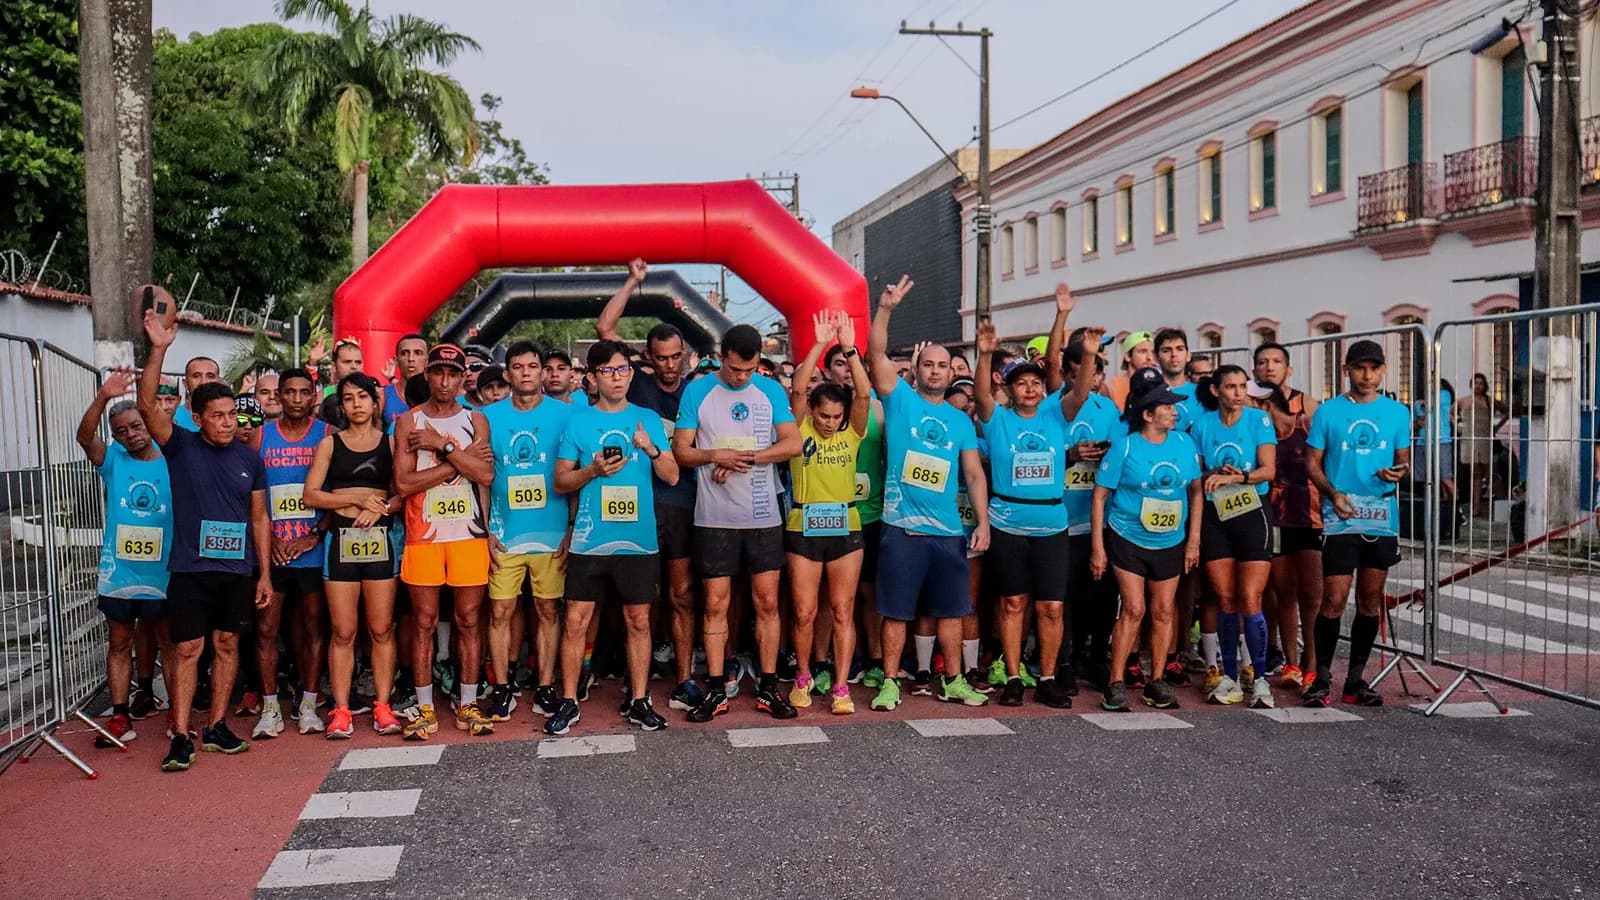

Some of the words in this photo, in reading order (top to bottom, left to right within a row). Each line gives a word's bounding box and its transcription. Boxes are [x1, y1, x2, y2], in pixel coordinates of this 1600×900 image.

[817, 440, 849, 454] Planeta
[816, 452, 852, 467] Energia
[912, 467, 940, 485] 685
[1017, 466, 1047, 478] 3837
[514, 488, 543, 503] 503
[1225, 492, 1252, 511] 446
[279, 498, 306, 512] 496
[437, 500, 466, 515] 346
[608, 500, 635, 515] 699
[957, 506, 973, 520] 56
[1150, 513, 1176, 527] 328
[1354, 507, 1385, 520] 3872
[810, 517, 841, 528] 3906
[125, 540, 153, 555] 635
[208, 537, 240, 550] 3934
[351, 541, 380, 556] 612
